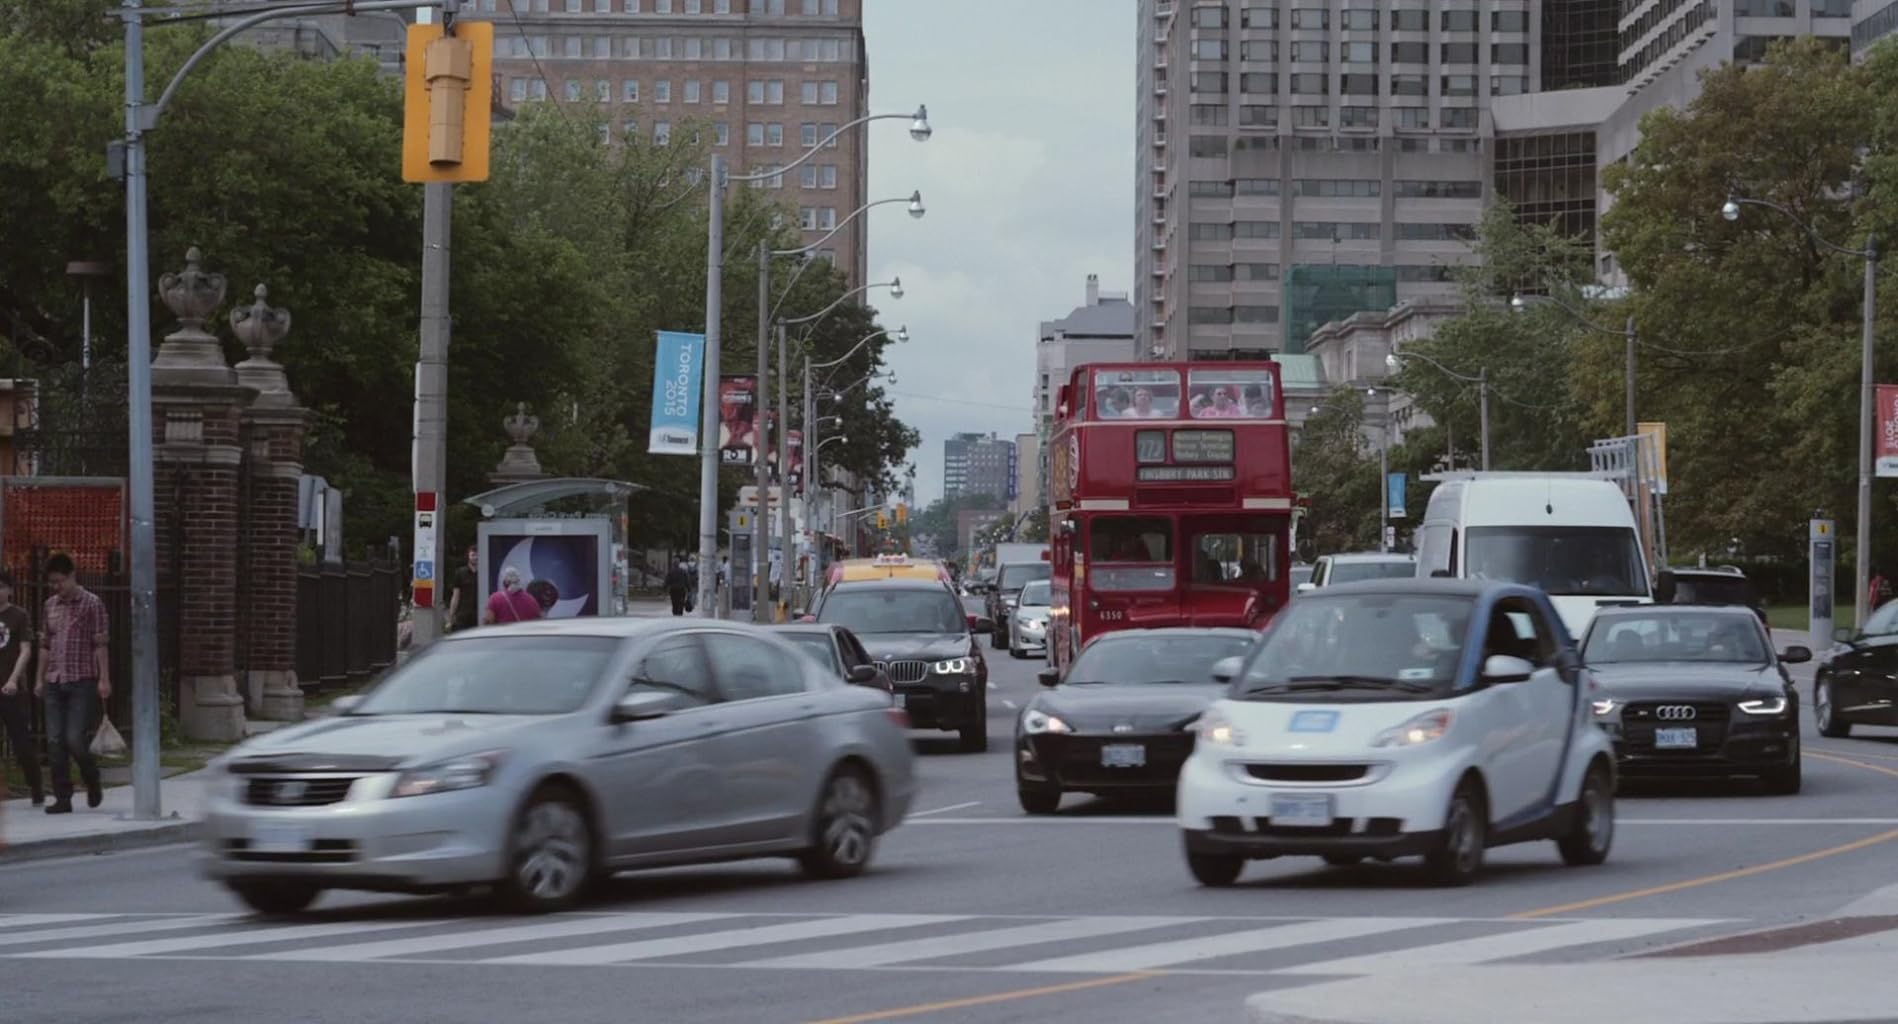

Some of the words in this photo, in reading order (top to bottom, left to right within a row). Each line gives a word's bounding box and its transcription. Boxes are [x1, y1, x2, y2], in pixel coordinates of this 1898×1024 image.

[676, 343, 692, 417] TORONTO
[664, 380, 677, 416] 2015
[1186, 468, 1210, 480] PARK
[1100, 610, 1122, 620] 6350
